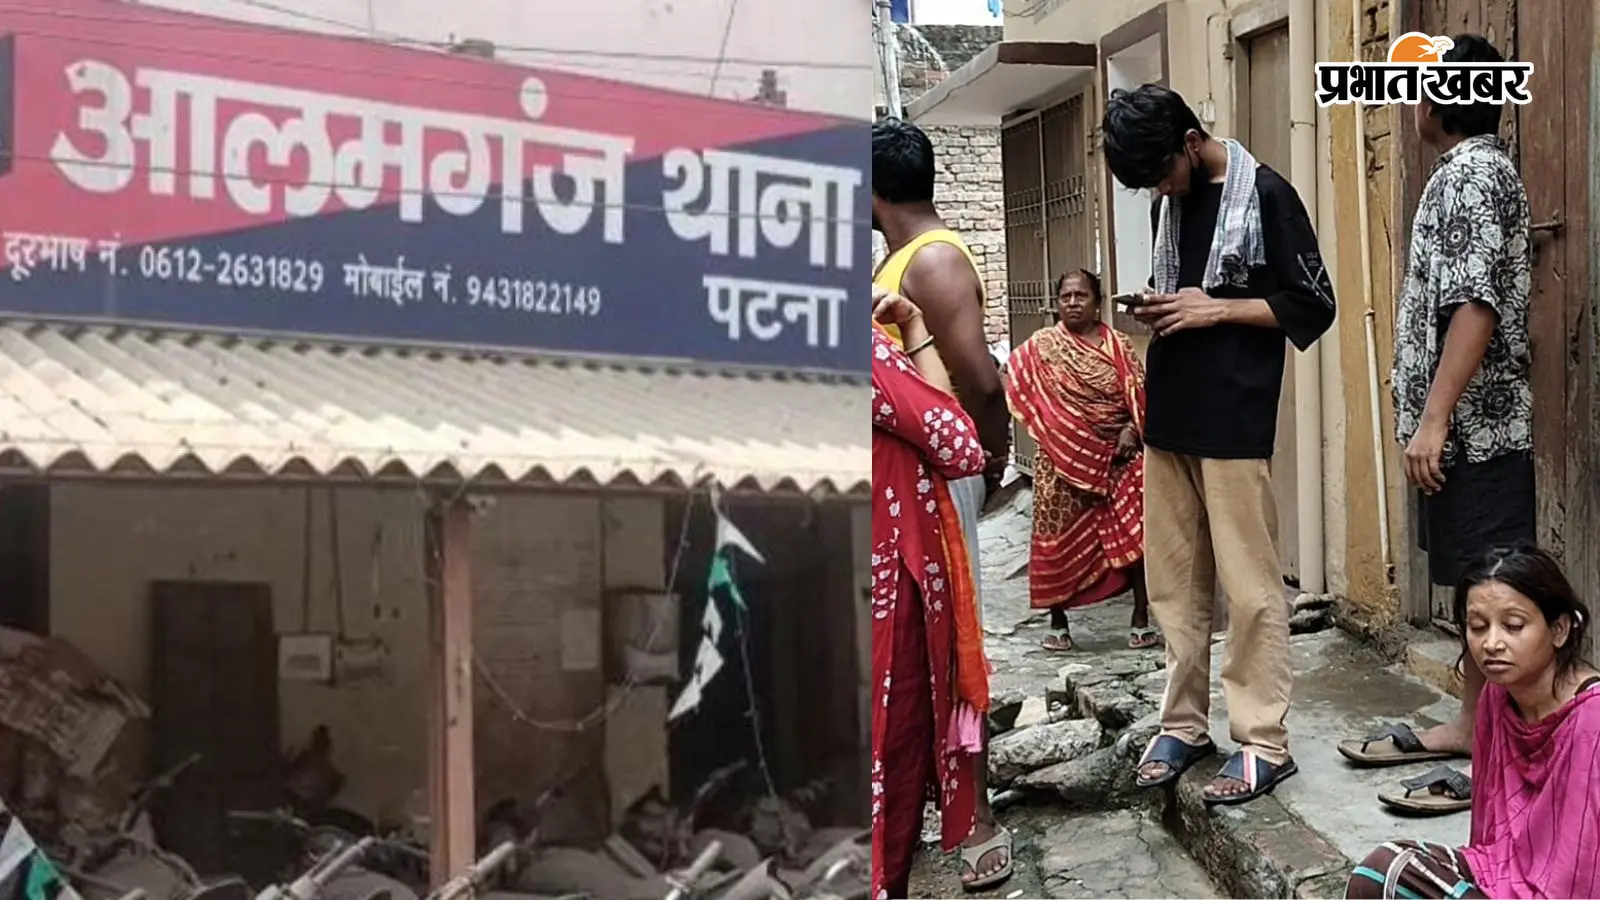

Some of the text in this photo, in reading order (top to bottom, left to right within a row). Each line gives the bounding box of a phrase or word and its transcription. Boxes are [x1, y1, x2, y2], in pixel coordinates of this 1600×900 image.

[50, 60, 861, 270] आलमगंज थाना
[3, 231, 89, 281] दूरभाष
[140, 244, 324, 293] 0612-2631829
[343, 253, 424, 305] मोबाईल
[466, 275, 602, 316] 9431822149
[703, 275, 847, 348] पटना
